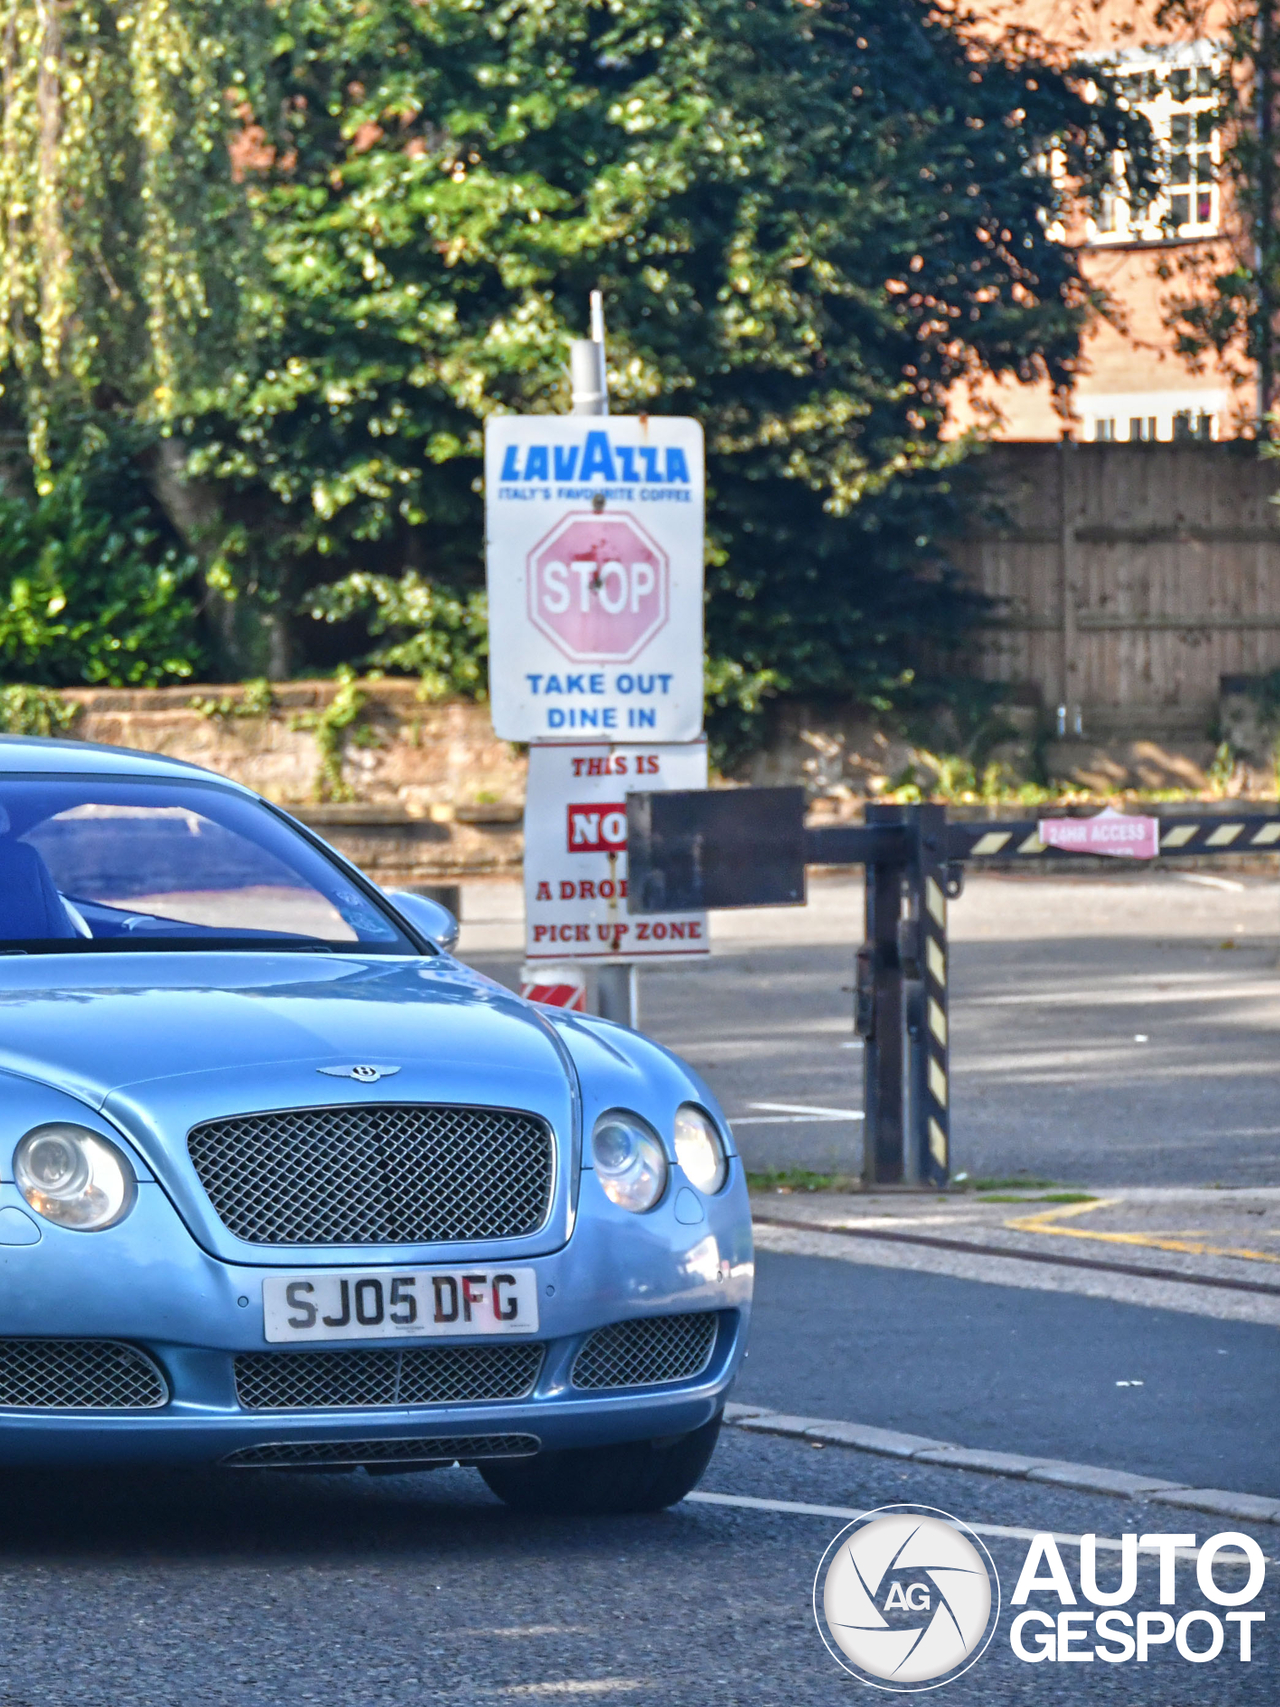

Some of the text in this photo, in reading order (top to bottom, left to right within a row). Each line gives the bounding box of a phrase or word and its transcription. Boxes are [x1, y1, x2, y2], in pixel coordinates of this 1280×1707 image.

[500, 430, 690, 482] LAVAZZA
[499, 487, 692, 502] ITALY'S FAVOURITE COFFEE
[543, 560, 655, 614] STOP
[526, 674, 674, 695] TAKE OUT
[548, 708, 657, 729] DINE IN
[572, 756, 660, 776] THIS IS
[1091, 823, 1145, 842] ACCESS
[536, 881, 552, 901] A
[533, 922, 702, 942] PICK UP ZONE
[431, 1274, 518, 1323] DFG
